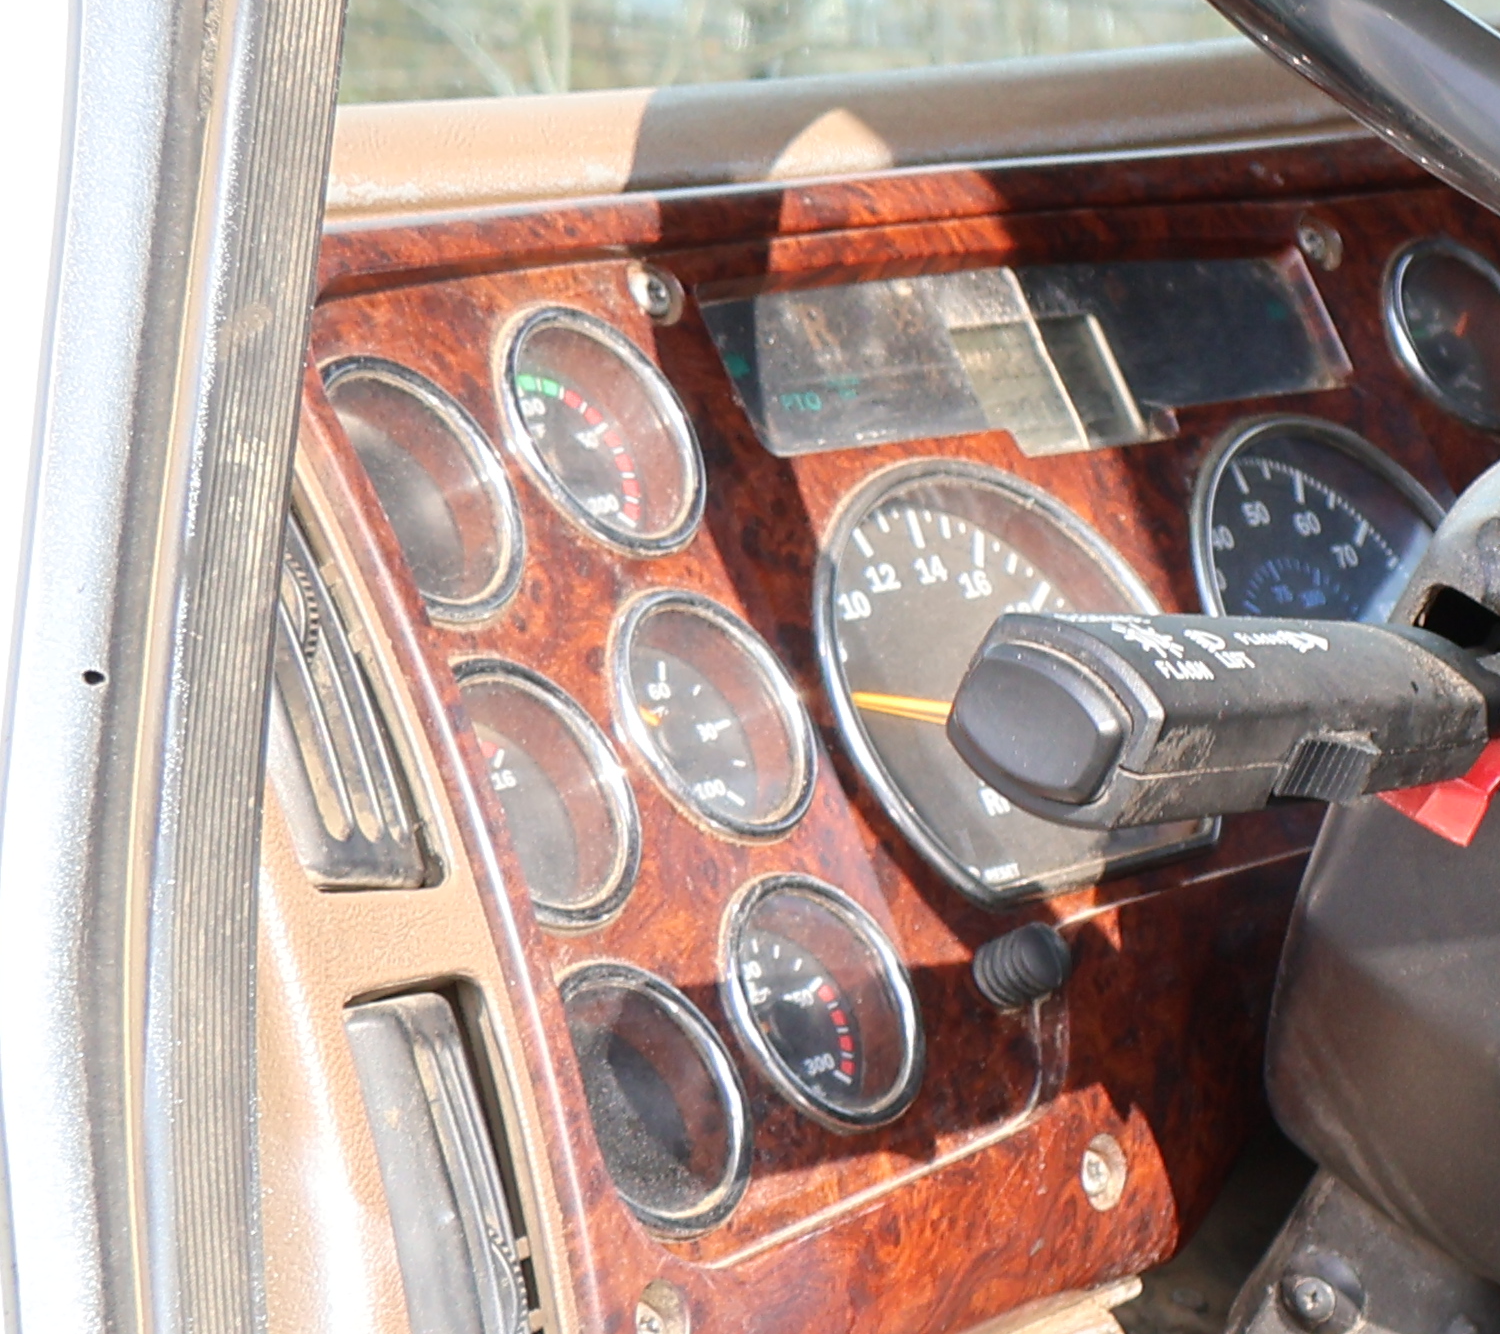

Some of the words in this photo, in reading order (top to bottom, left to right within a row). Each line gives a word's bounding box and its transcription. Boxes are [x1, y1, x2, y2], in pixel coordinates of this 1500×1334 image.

[1240, 500, 1271, 527] 50
[1292, 510, 1322, 536] 60
[1330, 544, 1359, 568] 70
[863, 563, 901, 593] 12
[914, 555, 948, 585] 14
[958, 570, 992, 599] 16
[837, 590, 872, 620] 10
[647, 682, 671, 701] 60
[694, 779, 726, 800] 100
[803, 1053, 836, 1076] 300
